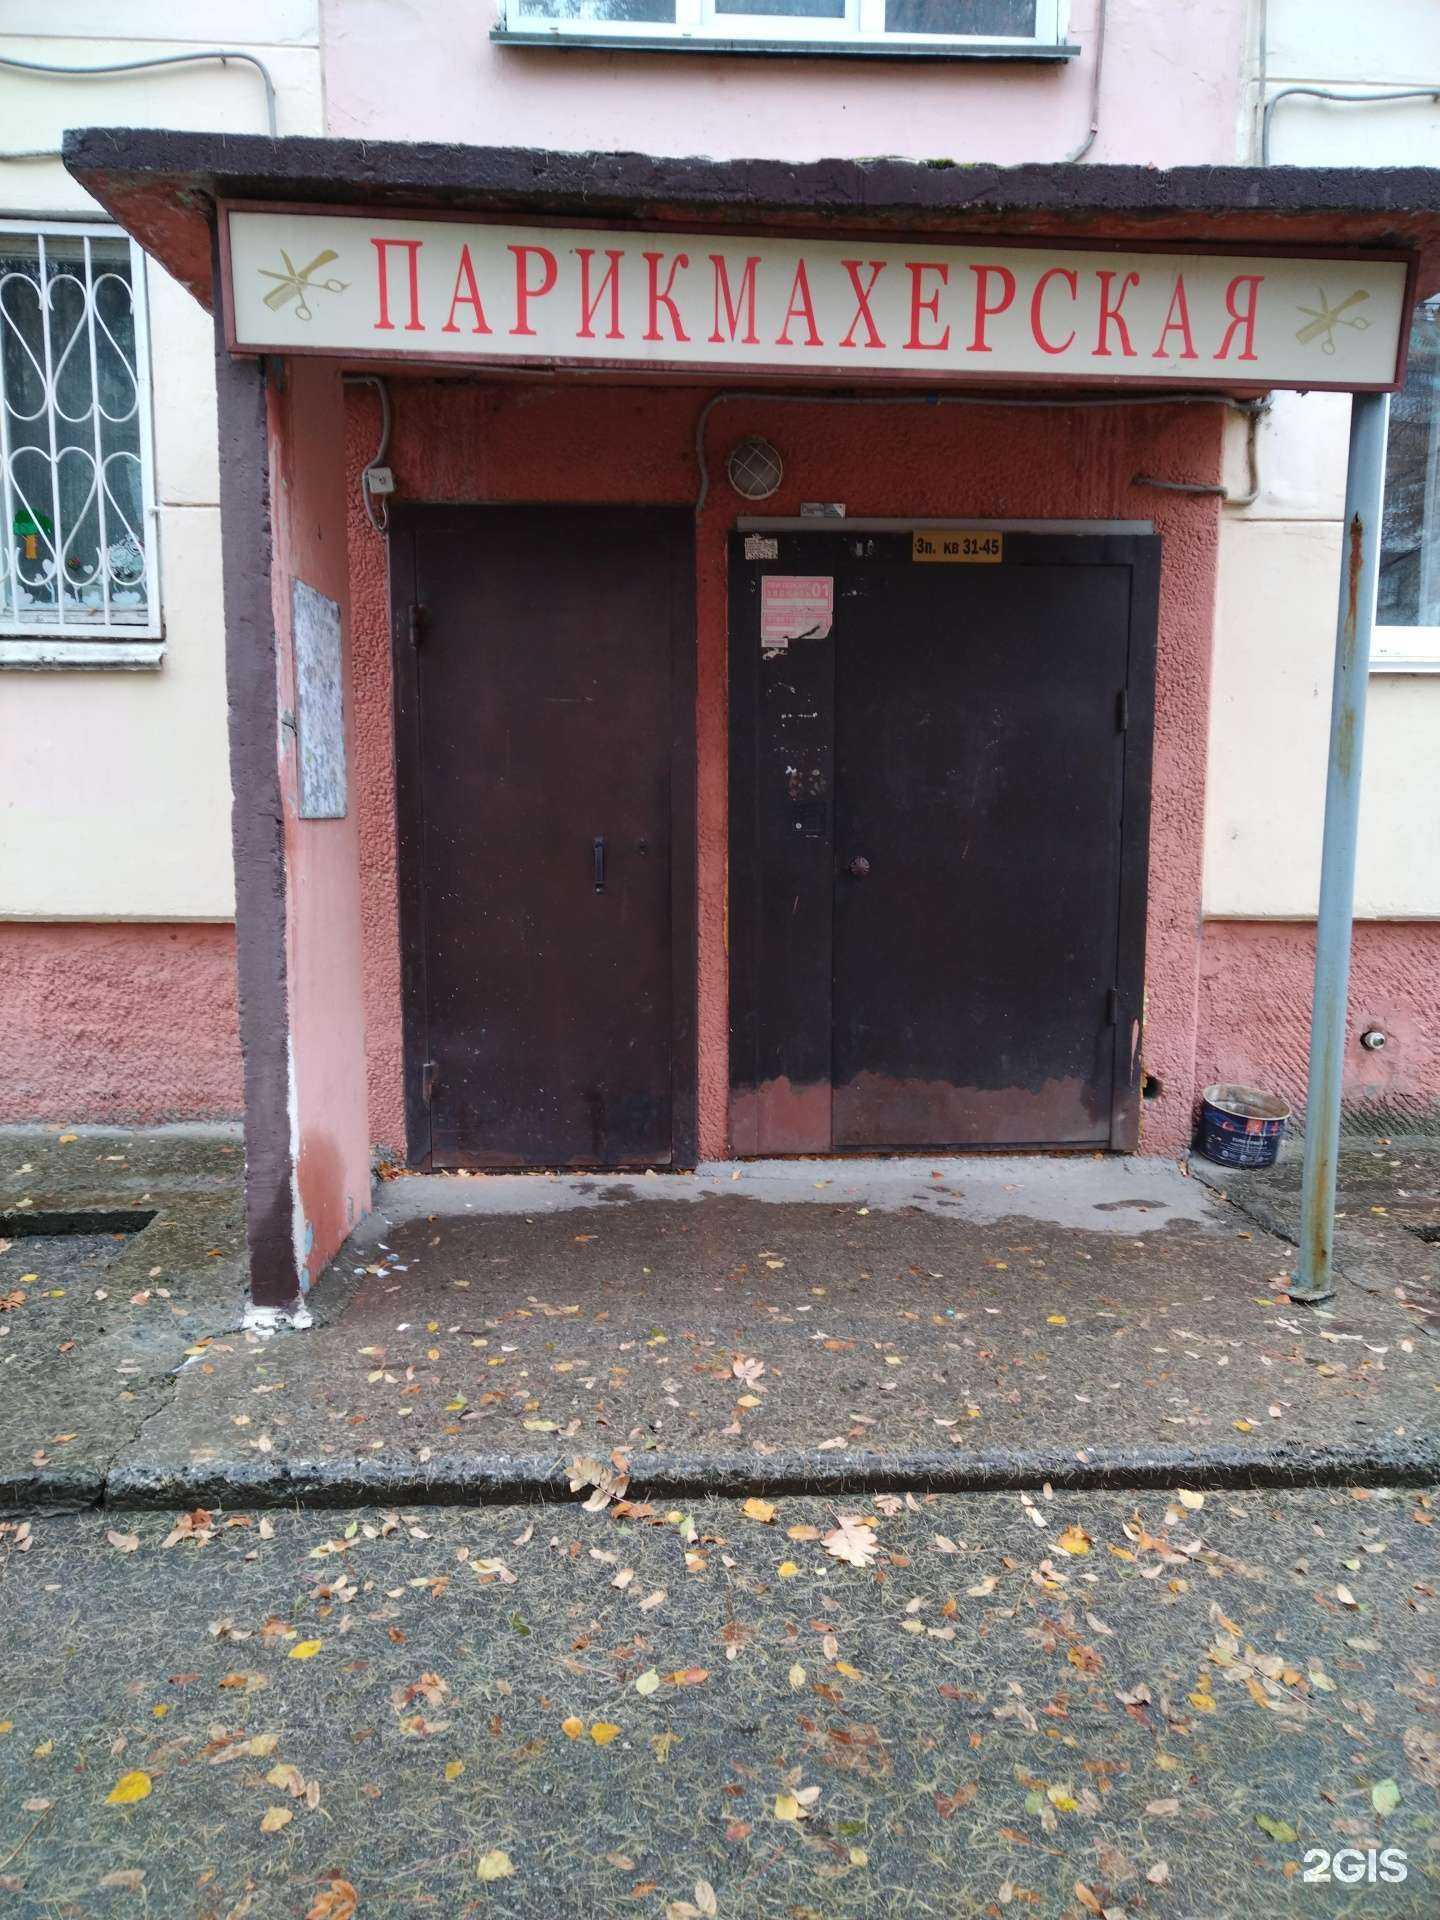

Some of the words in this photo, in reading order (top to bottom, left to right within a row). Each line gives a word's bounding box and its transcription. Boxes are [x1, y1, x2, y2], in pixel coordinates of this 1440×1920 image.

[370, 238, 1265, 361] ПАРИКМАХЕРСКАЯ
[916, 538, 937, 554] 3п.
[943, 541, 960, 555] кв
[962, 538, 1000, 555] 31-45
